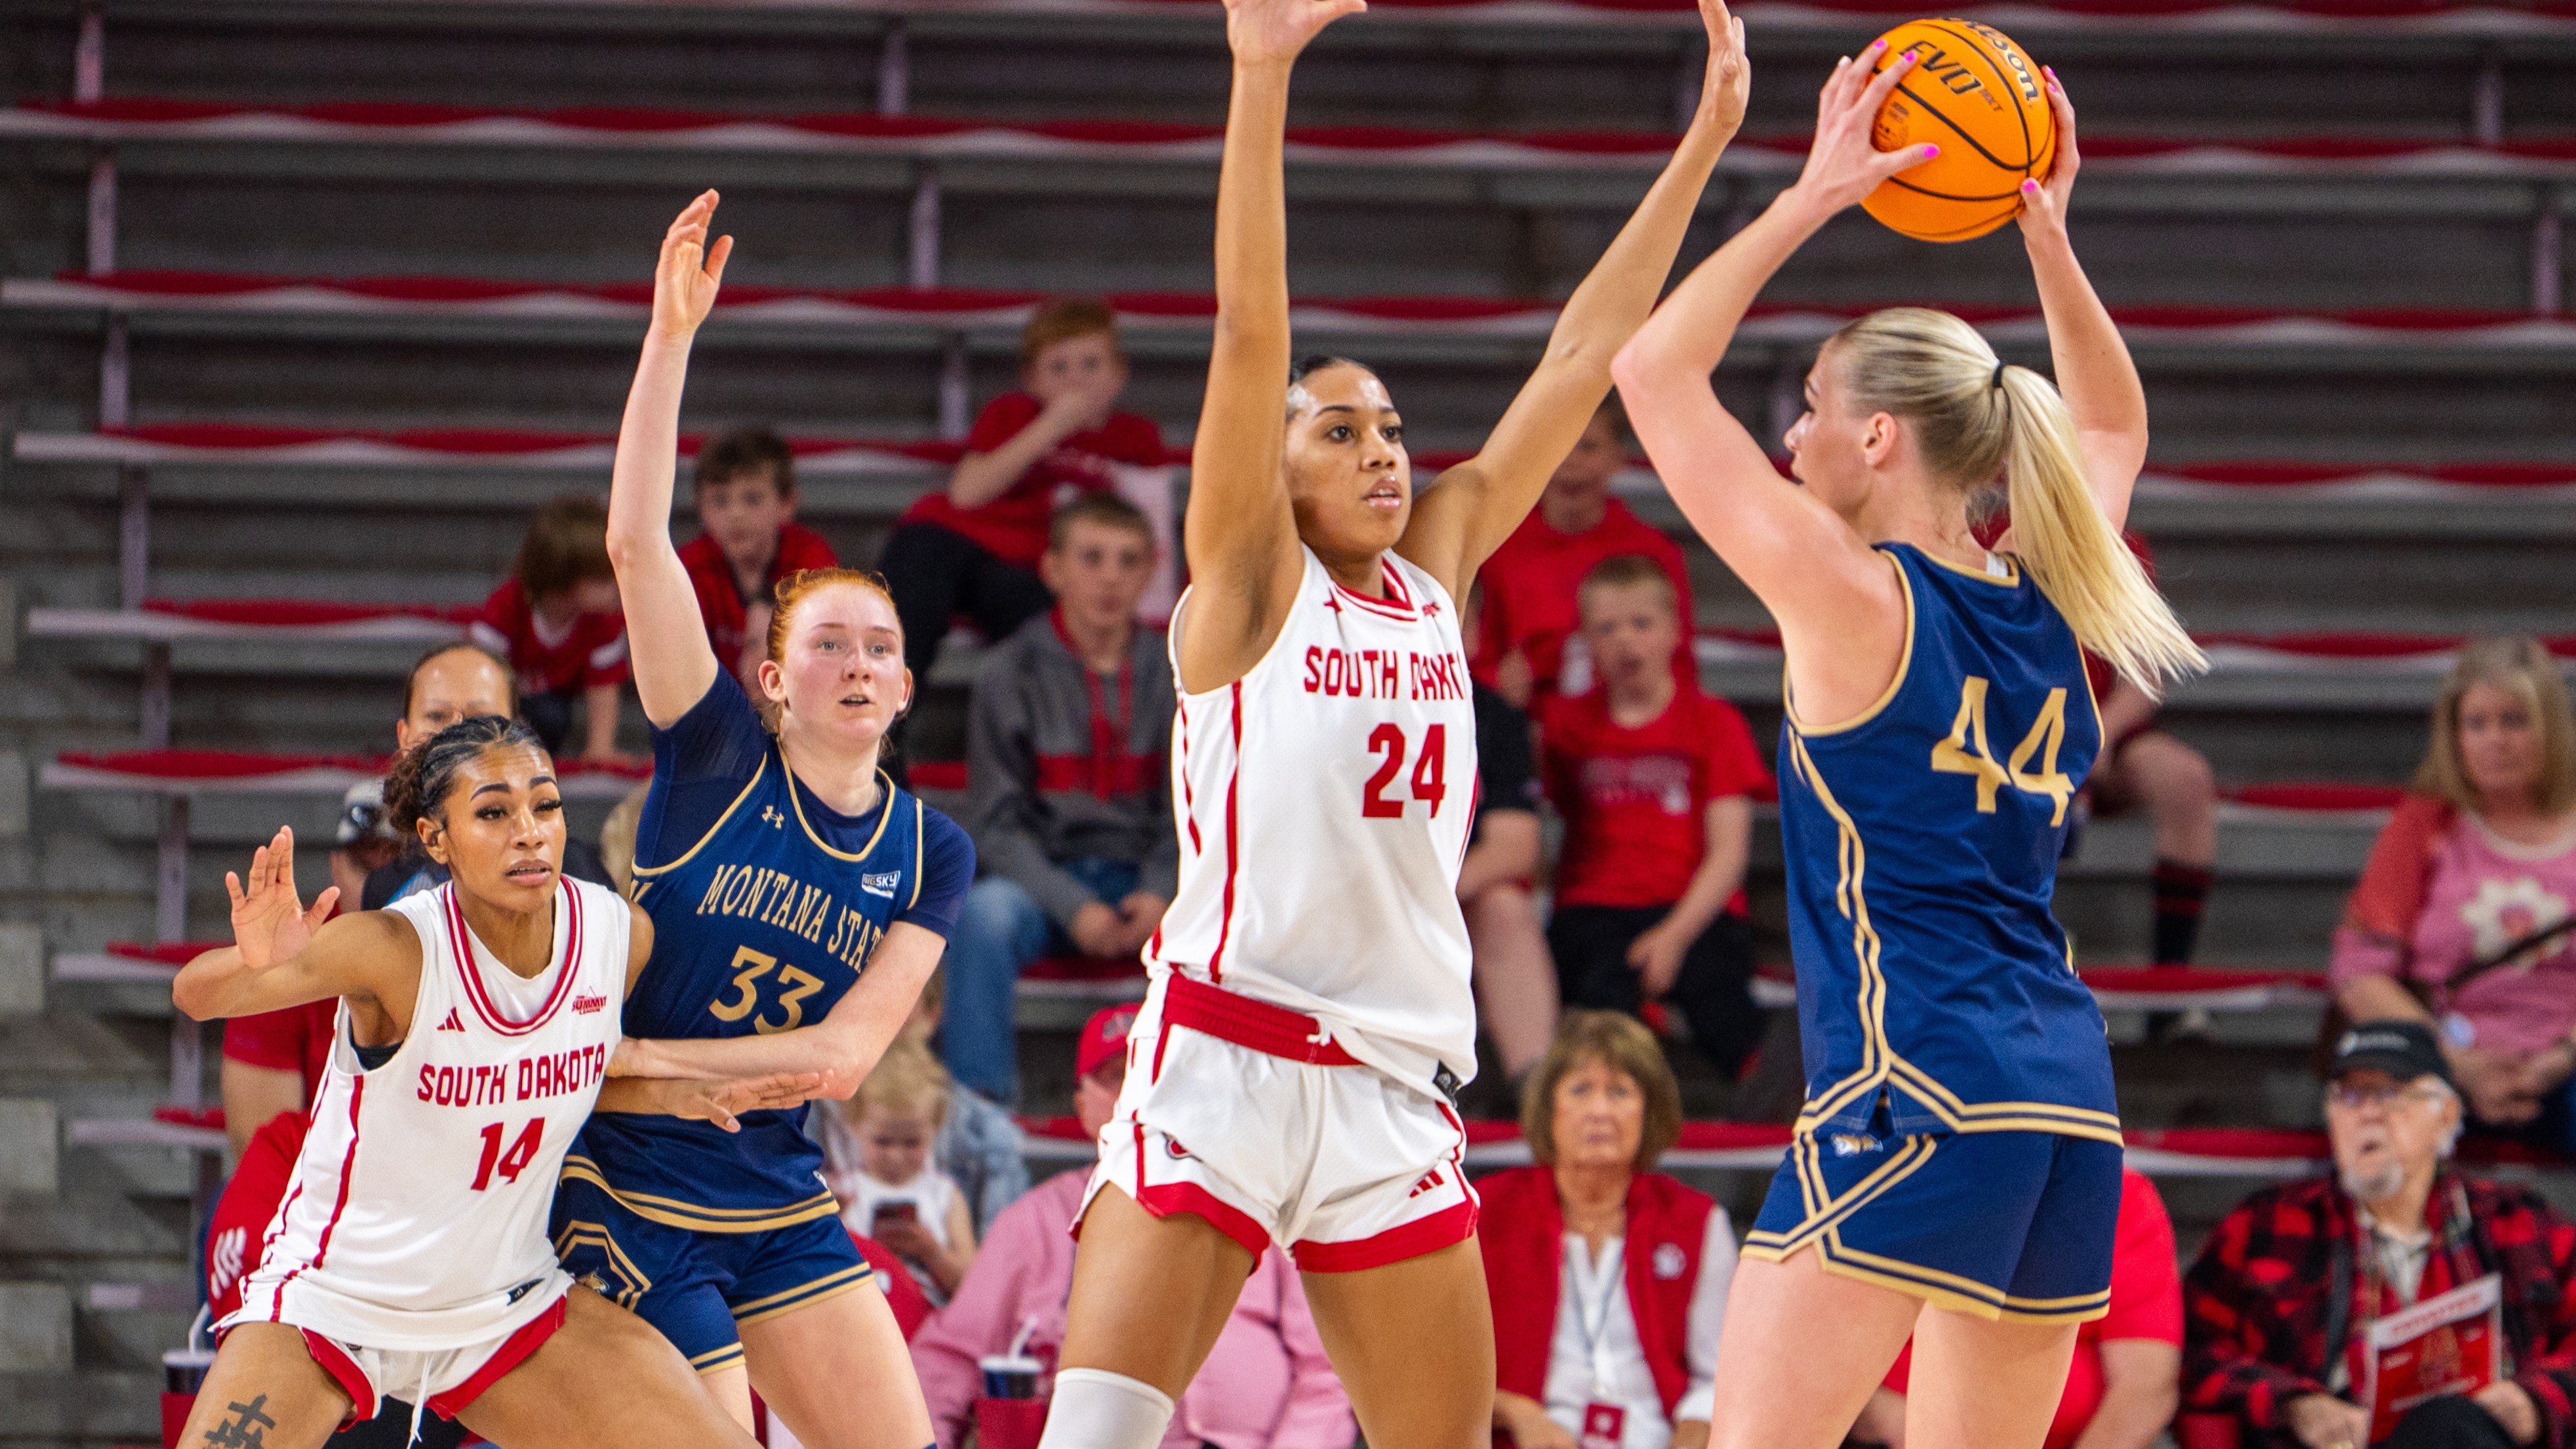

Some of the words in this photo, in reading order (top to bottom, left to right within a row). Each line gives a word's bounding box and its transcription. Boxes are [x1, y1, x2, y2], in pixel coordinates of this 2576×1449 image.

[1899, 40, 1983, 94] EVO
[1304, 645, 1399, 700] SOUTH
[1362, 723, 1446, 819] 24
[1931, 675, 2075, 827] 44
[696, 864, 832, 944] MONTANA
[827, 905, 883, 974] STAT
[572, 995, 607, 1012] SUMMIT
[709, 945, 824, 1035] 33
[417, 1063, 508, 1107] SOUTH
[517, 1042, 605, 1101] DAKOTA
[470, 1117, 545, 1191] 14
